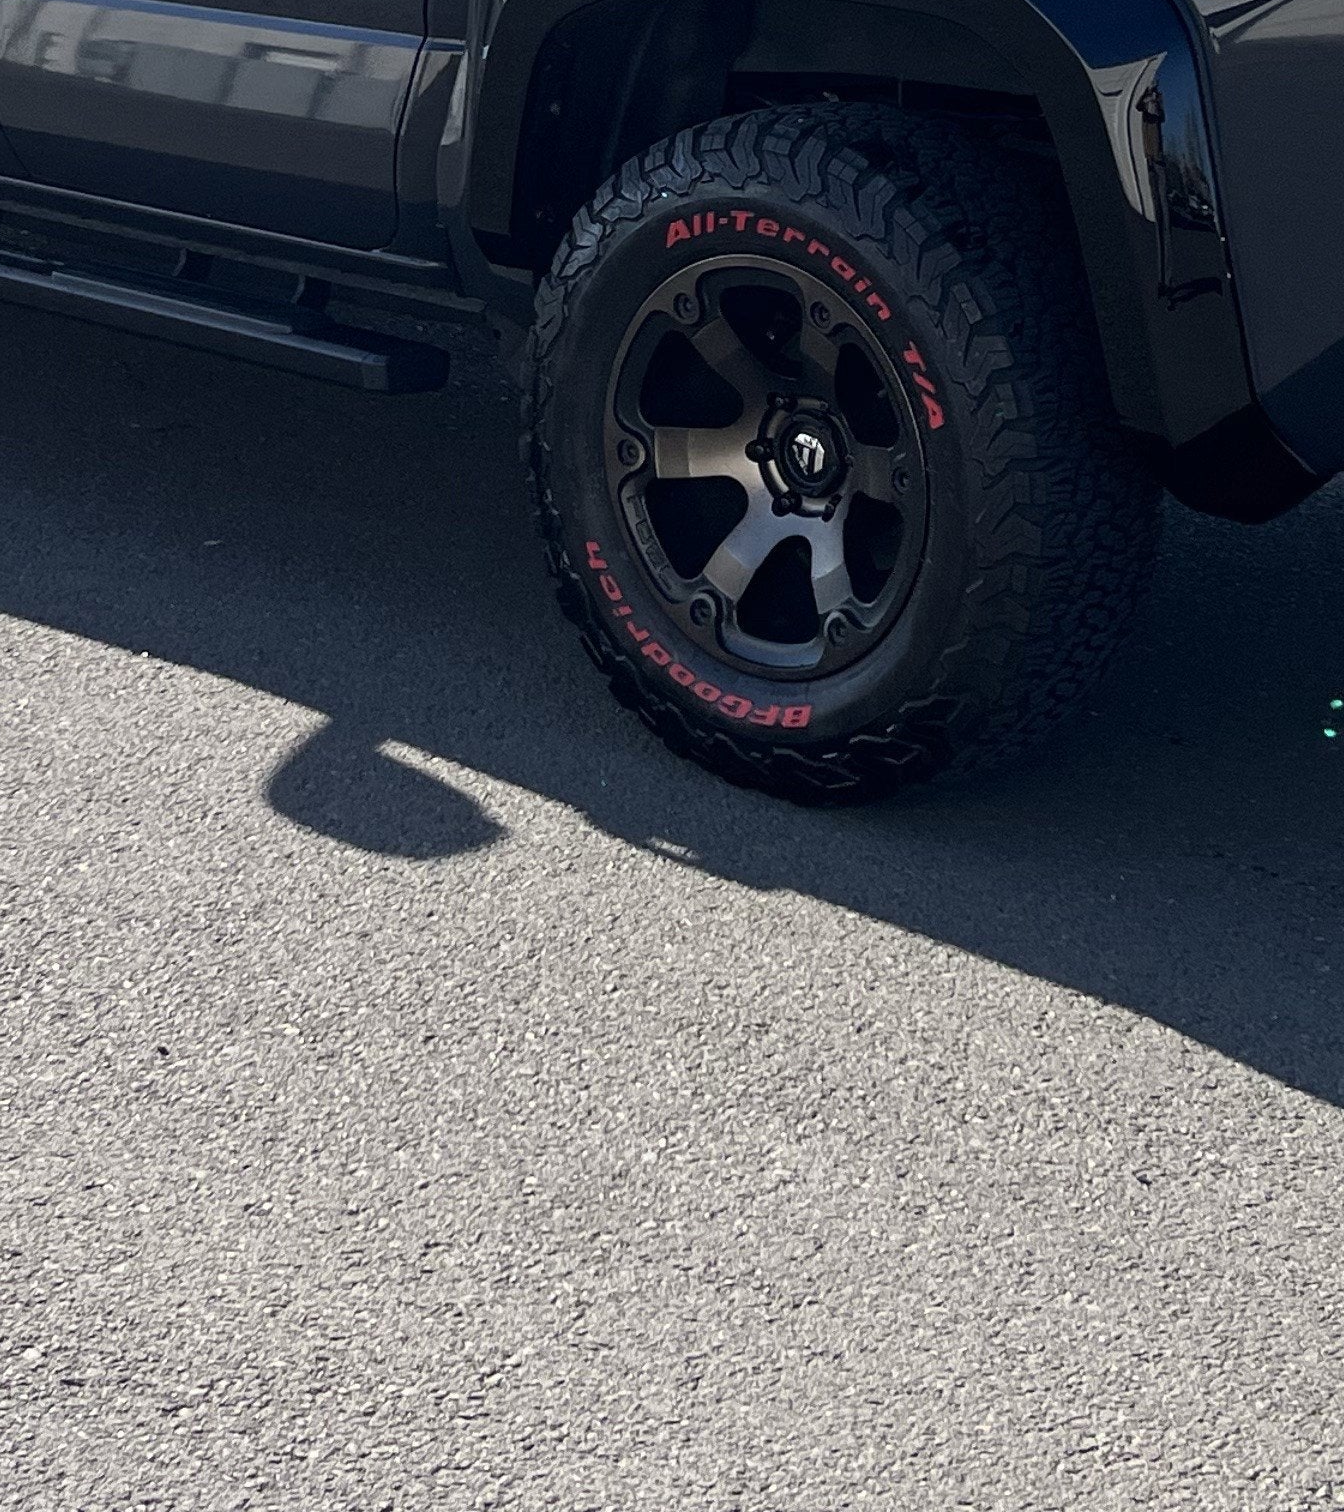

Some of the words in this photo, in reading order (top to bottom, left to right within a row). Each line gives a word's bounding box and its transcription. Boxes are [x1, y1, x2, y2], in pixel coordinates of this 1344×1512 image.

[665, 210, 892, 321] All-Terrain
[903, 340, 946, 430] T/A
[585, 539, 813, 729] BFGoodrich
